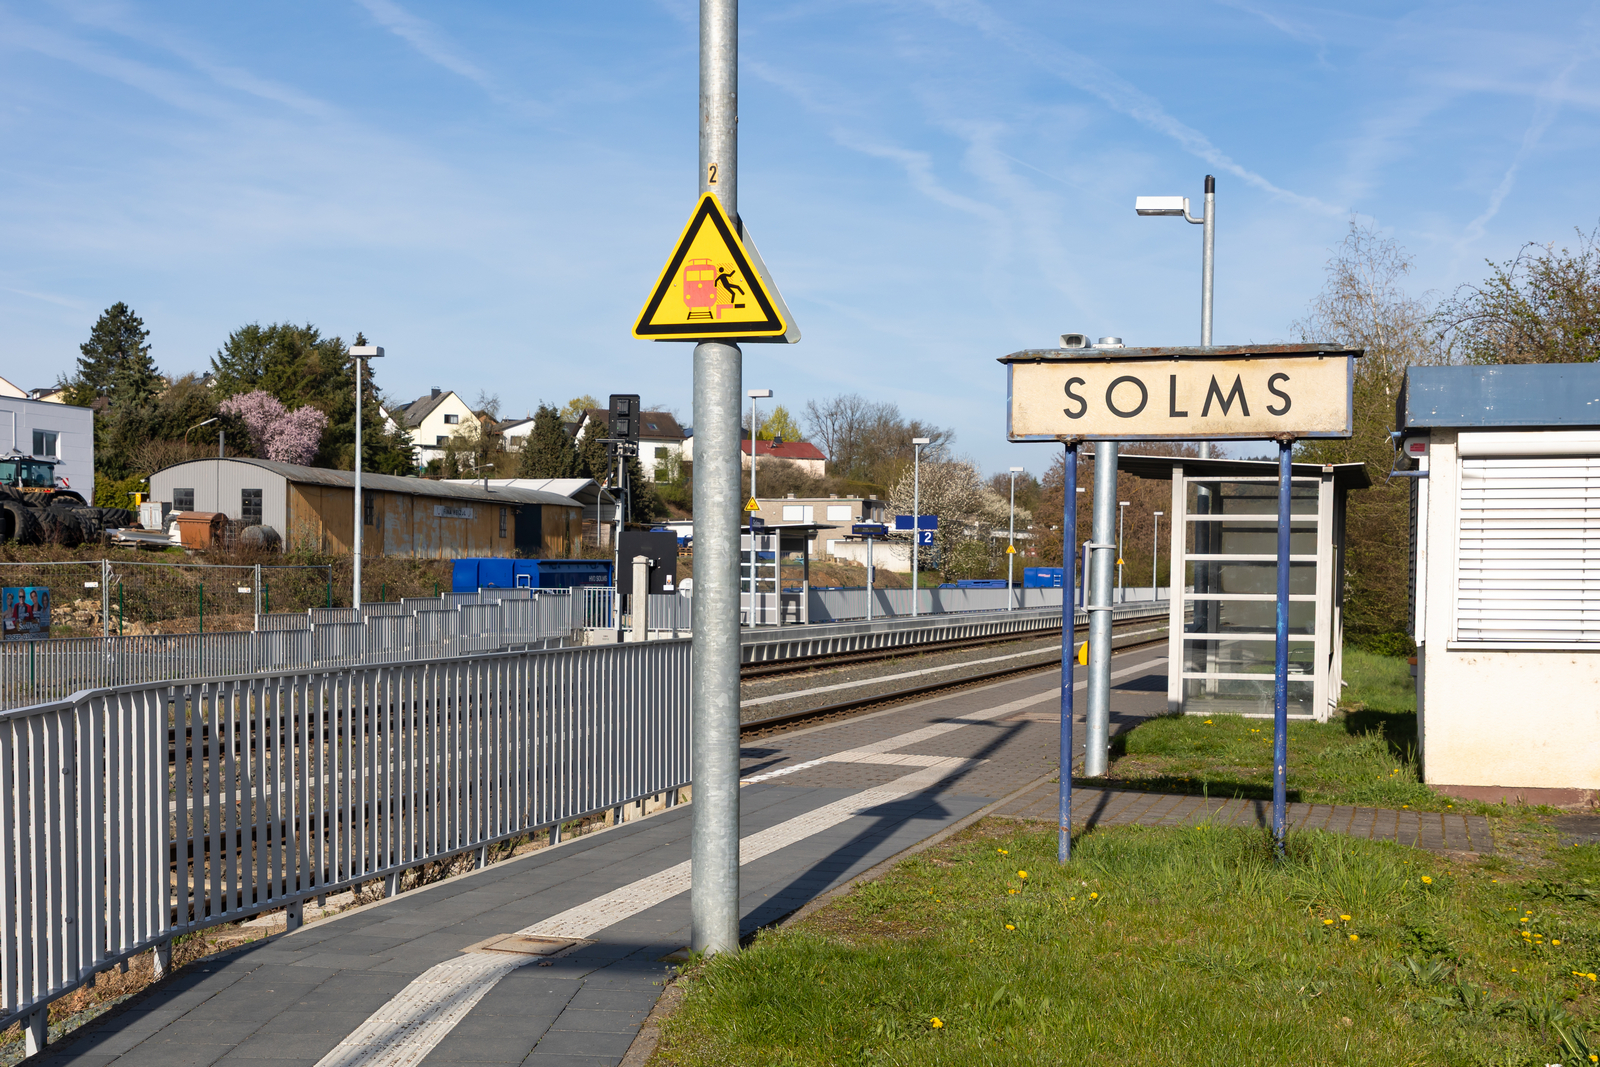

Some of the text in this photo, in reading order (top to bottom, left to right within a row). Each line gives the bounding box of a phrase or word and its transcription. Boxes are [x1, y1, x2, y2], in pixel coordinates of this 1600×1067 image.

[709, 165, 717, 183] 2
[1063, 372, 1292, 420] SOLMS
[924, 532, 932, 543] 2
